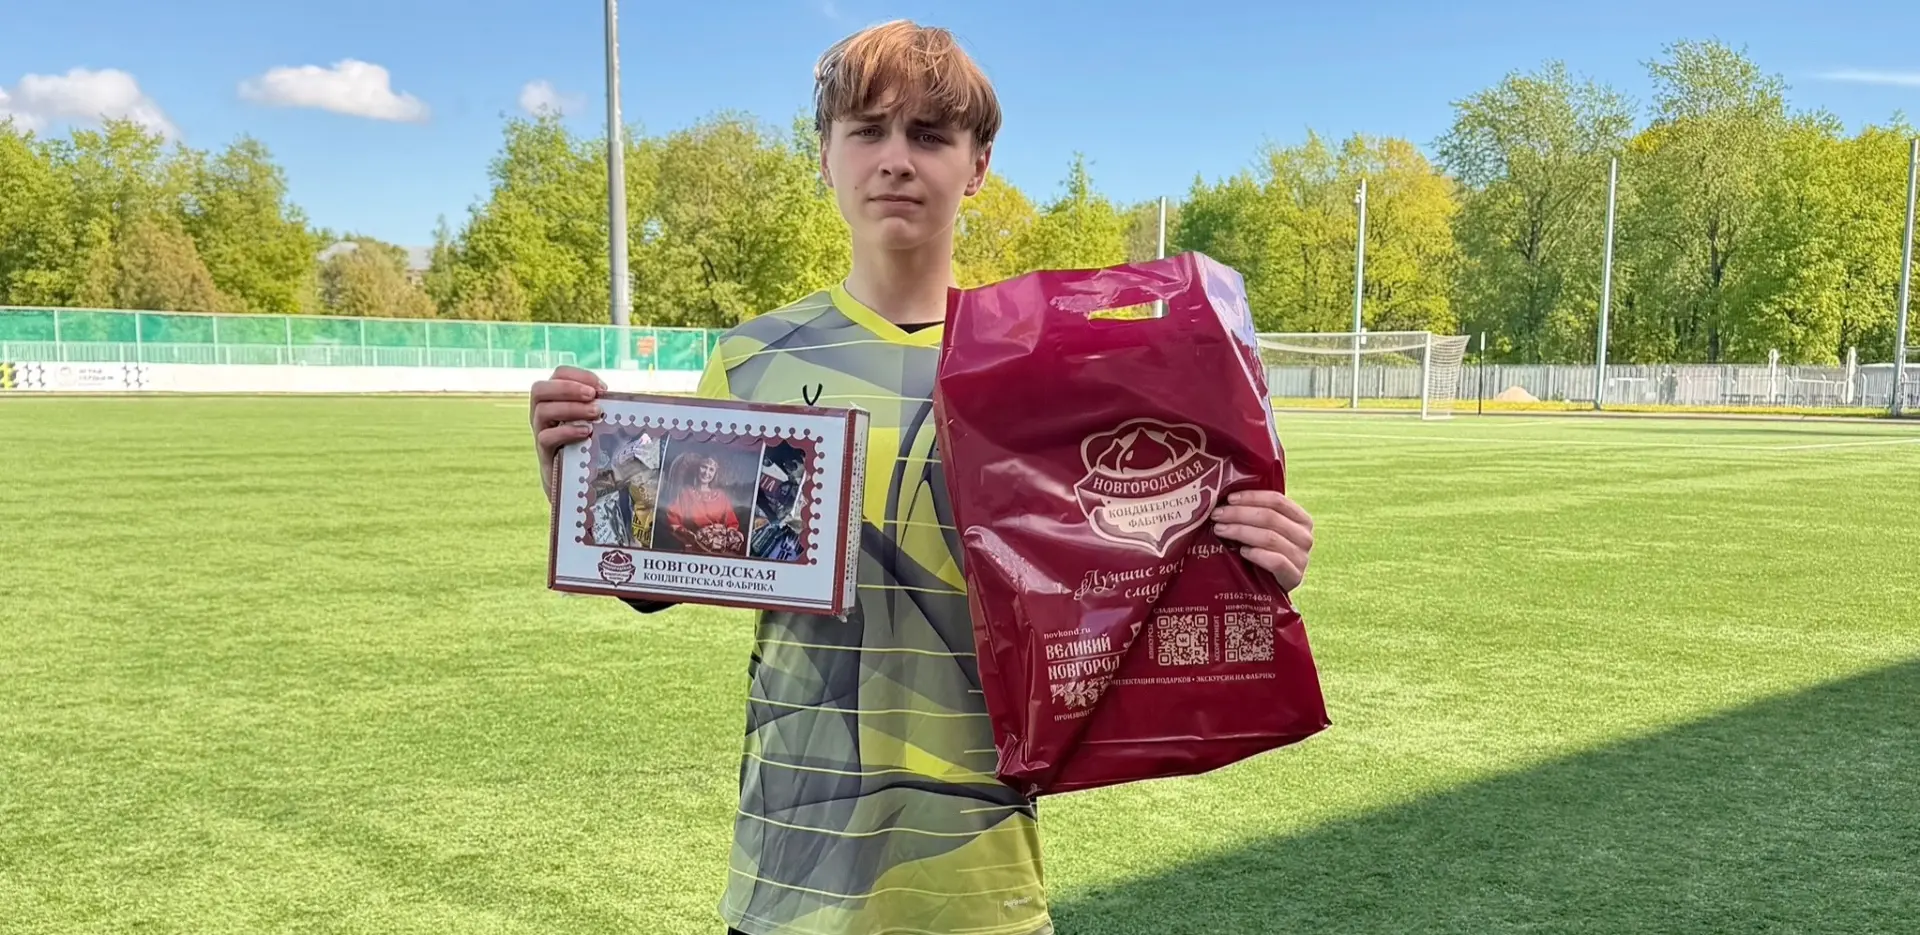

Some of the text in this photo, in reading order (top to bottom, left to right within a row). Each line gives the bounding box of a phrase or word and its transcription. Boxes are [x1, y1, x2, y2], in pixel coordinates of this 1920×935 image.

[1093, 460, 1204, 494] НОВГОРОДСКАЯ
[1108, 494, 1198, 518] КОНДИТЕРСКАЯ
[1128, 511, 1182, 528] ФАБРИКА
[643, 558, 777, 581] НОВГОРОДСКАЯ
[643, 572, 724, 587] КОНДИТЕРСКАЯ
[726, 580, 774, 592] ФАБРИКА
[1074, 565, 1154, 600] Лучшие
[1044, 628, 1091, 639] novkond.ru
[1045, 633, 1112, 660] ВЕЛИКИЙ
